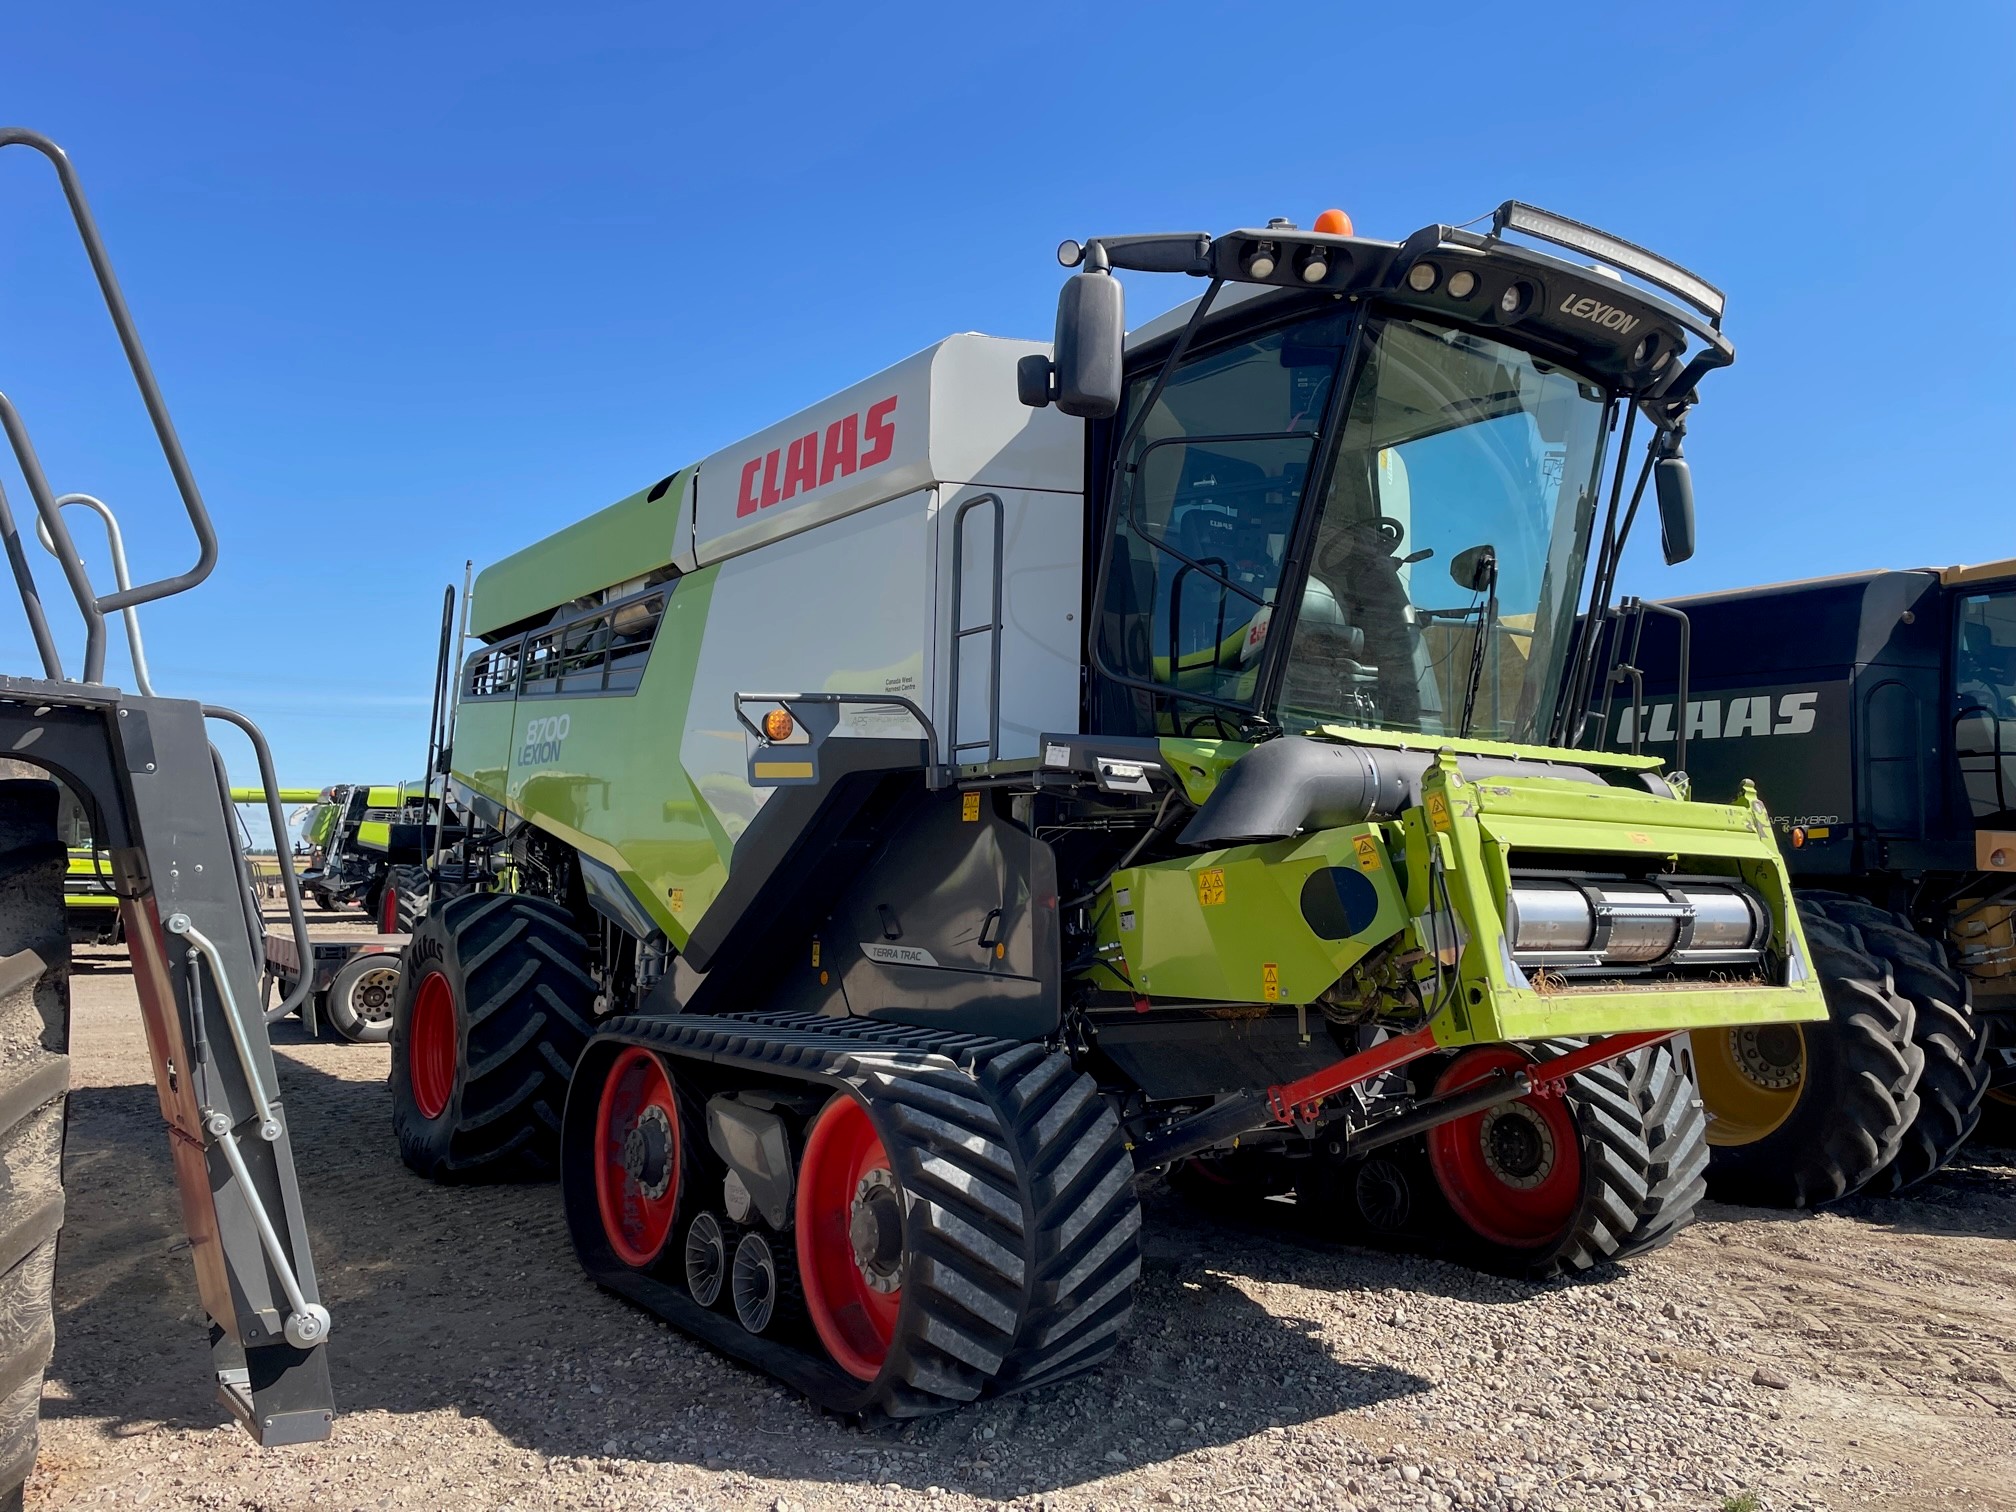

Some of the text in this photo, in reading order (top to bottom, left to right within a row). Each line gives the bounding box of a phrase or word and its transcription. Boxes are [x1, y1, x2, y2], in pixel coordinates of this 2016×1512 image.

[1560, 293, 1640, 335] LEXION
[737, 395, 898, 518] CLAAS
[885, 678, 901, 686] Canada
[526, 713, 570, 746] 8700
[1616, 692, 1819, 744] CLAAS
[517, 740, 562, 767] LEXION
[1793, 815, 1839, 825] HYBRID
[408, 934, 444, 990] Mitas
[872, 947, 922, 961] TERRA TRAC
